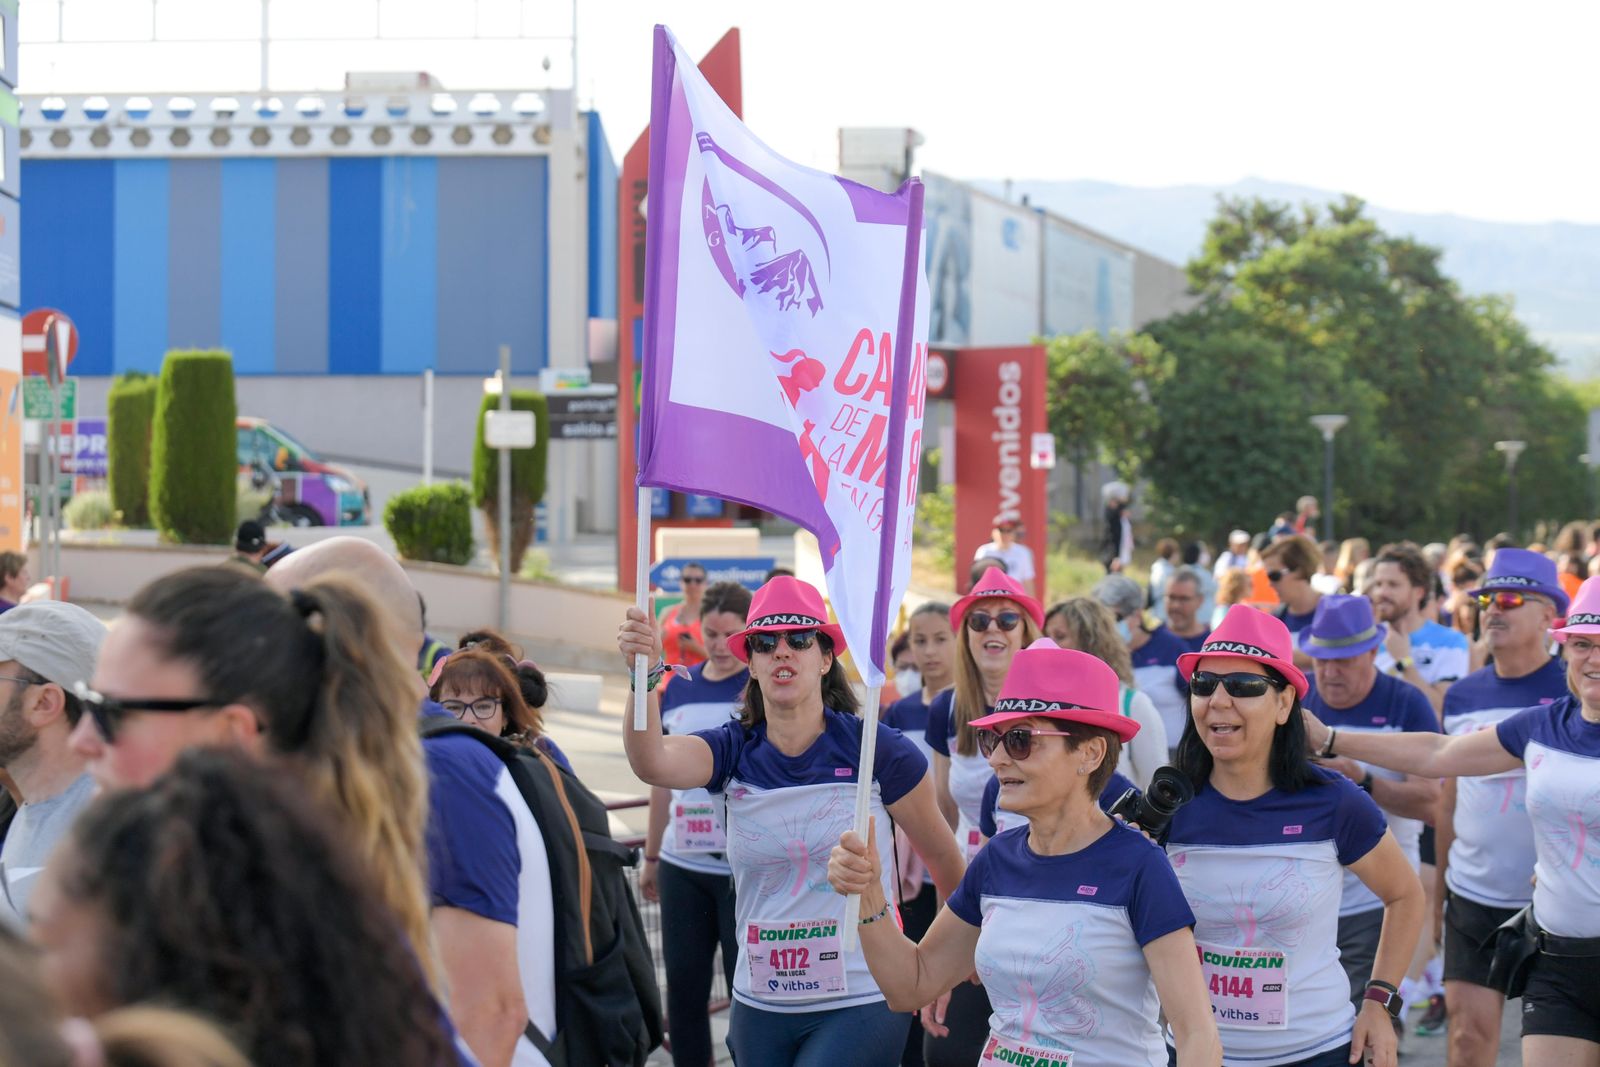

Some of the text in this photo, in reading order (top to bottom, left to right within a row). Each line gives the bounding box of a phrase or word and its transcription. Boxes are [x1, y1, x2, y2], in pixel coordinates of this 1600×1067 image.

[830, 403, 870, 437] DE
[759, 924, 837, 941] COVIRAN
[769, 947, 811, 970] 4172
[1203, 951, 1284, 969] COVIRAN
[781, 980, 820, 992] vithas
[1209, 973, 1254, 999] 4144
[1220, 1008, 1259, 1021] vithas
